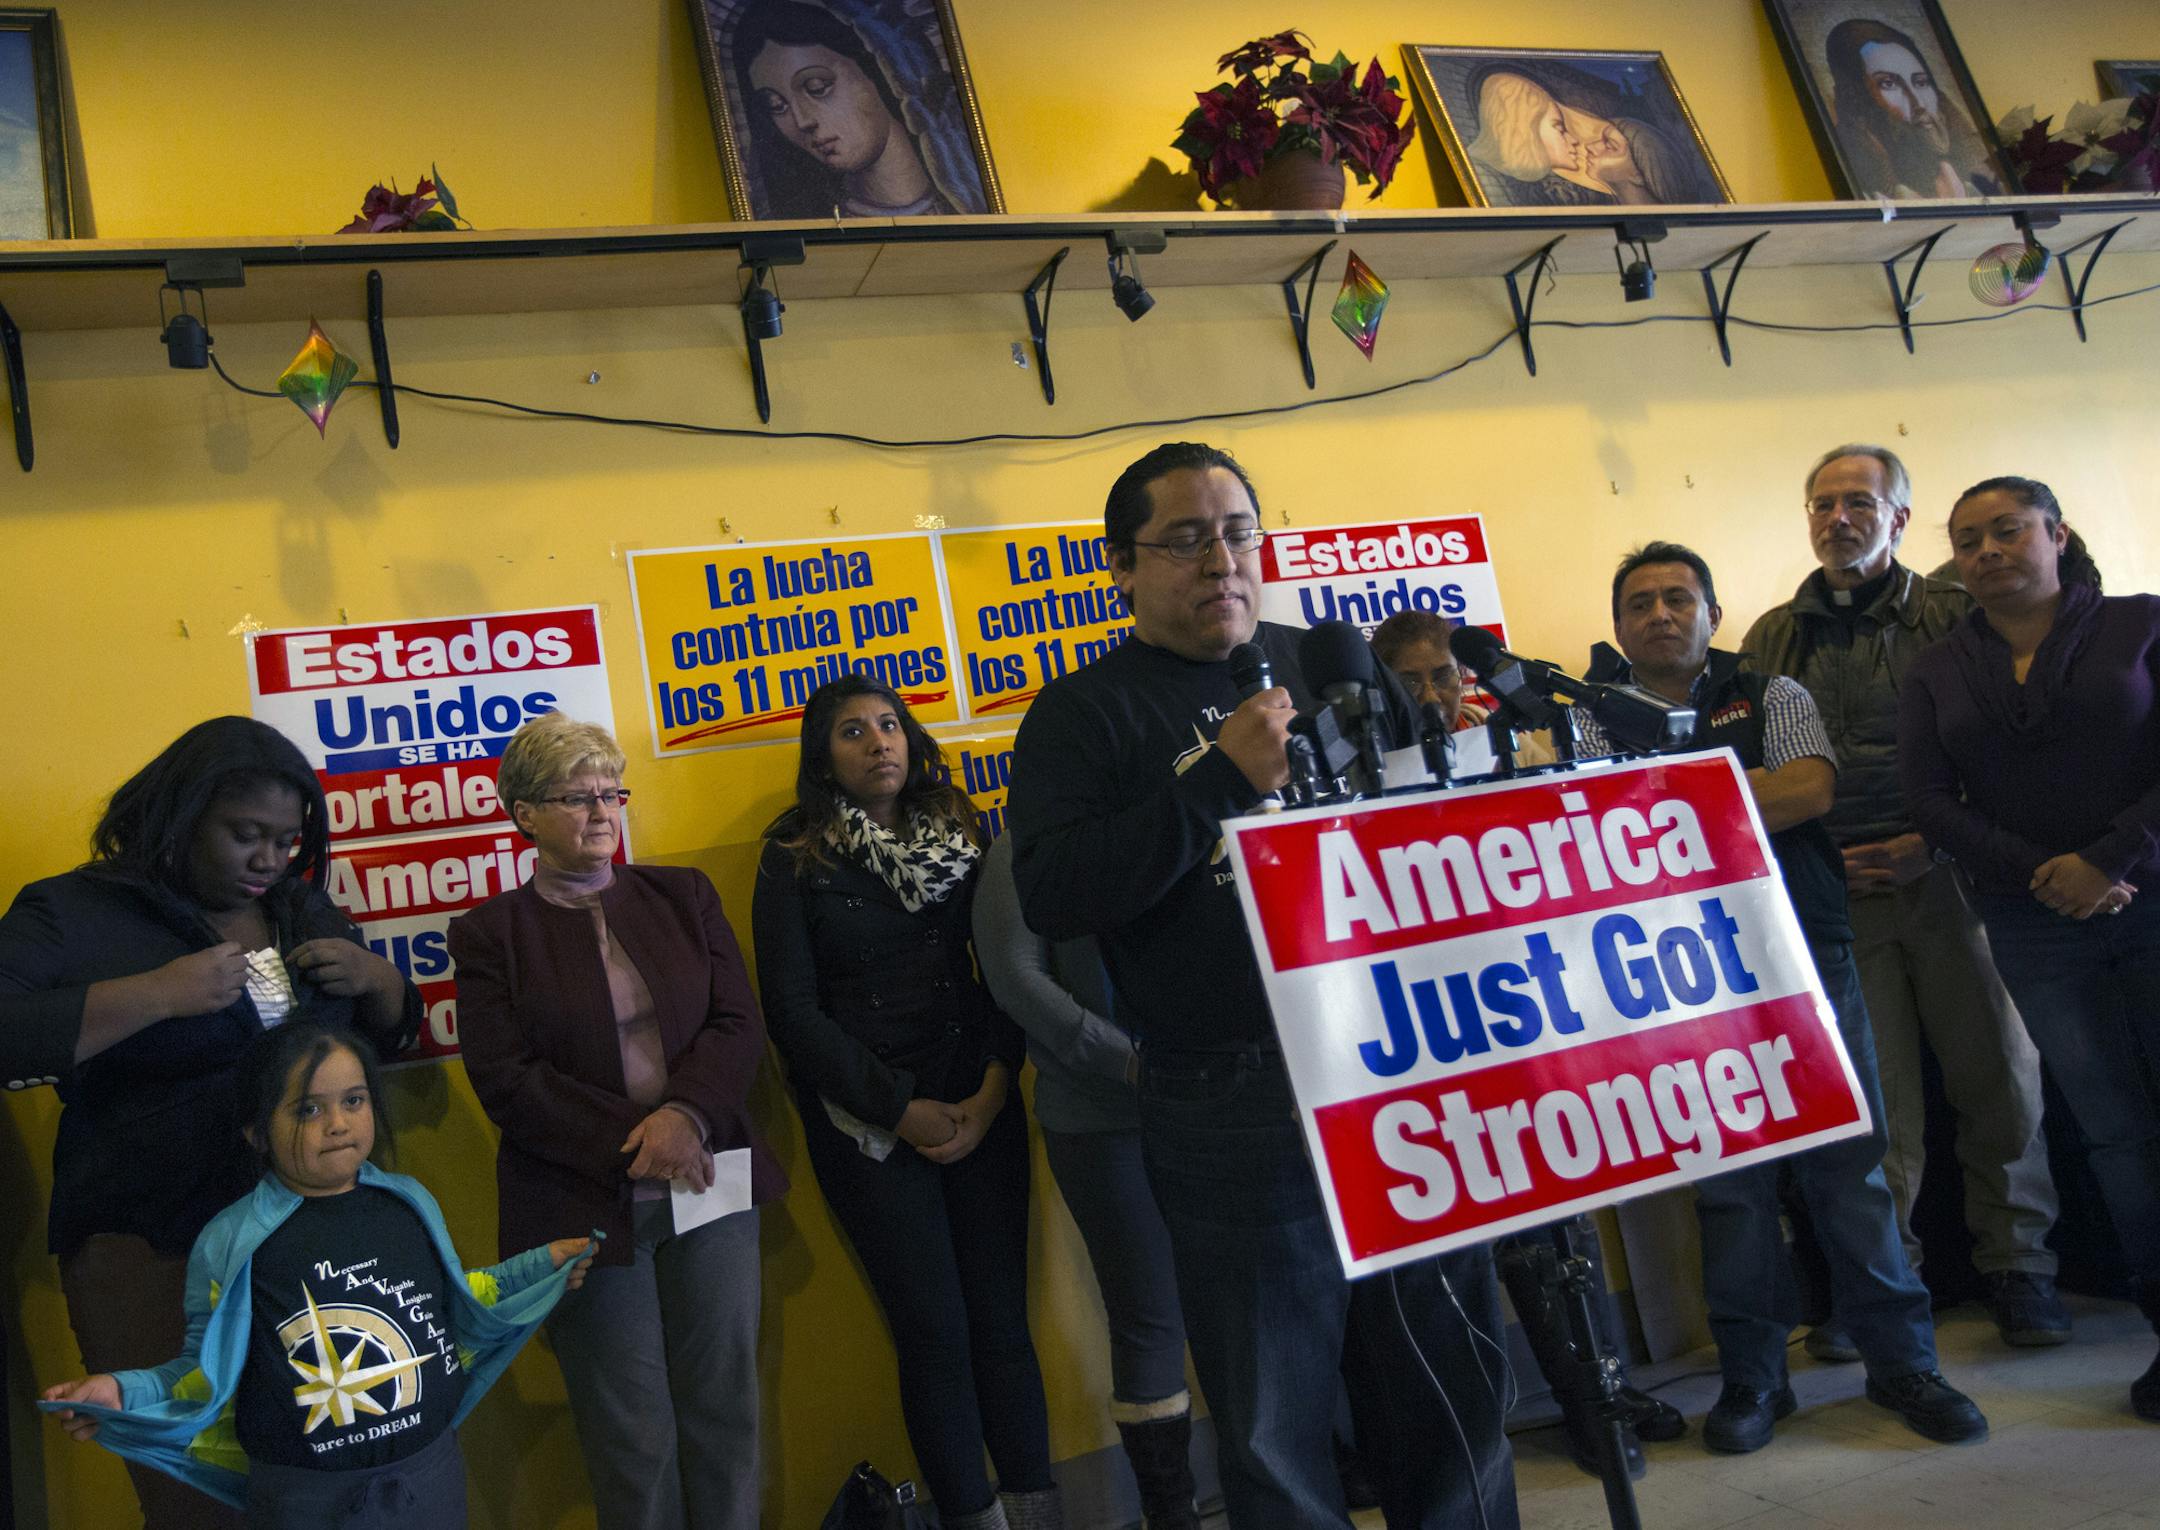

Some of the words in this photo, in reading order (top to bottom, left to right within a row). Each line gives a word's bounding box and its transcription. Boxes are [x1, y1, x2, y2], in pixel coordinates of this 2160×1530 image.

[705, 561, 755, 610] La
[763, 548, 873, 600] lucha
[1006, 542, 1052, 586] La
[1058, 534, 1111, 577] luc
[1272, 525, 1470, 579] Estados
[1299, 578, 1466, 628] Unidos
[285, 621, 573, 688] Estados
[672, 604, 841, 670] contnúa
[852, 596, 918, 649] por
[968, 652, 1028, 697] los
[1034, 638, 1067, 684] 11
[315, 685, 557, 750] Unidos
[658, 677, 724, 729] los
[733, 665, 771, 714] 11
[1711, 709, 1748, 728] HERE
[399, 745, 438, 766] SE
[448, 741, 488, 760] HA
[1318, 792, 1716, 943] America
[1358, 931, 1585, 1077] Just
[1592, 897, 1760, 1020] Got
[1372, 1034, 1796, 1223] Stronger
[314, 1257, 379, 1281] Necessary
[345, 1272, 375, 1292] And
[372, 1277, 416, 1296] Valuable
[347, 1433, 365, 1444] to
[367, 1411, 421, 1441] DREAM
